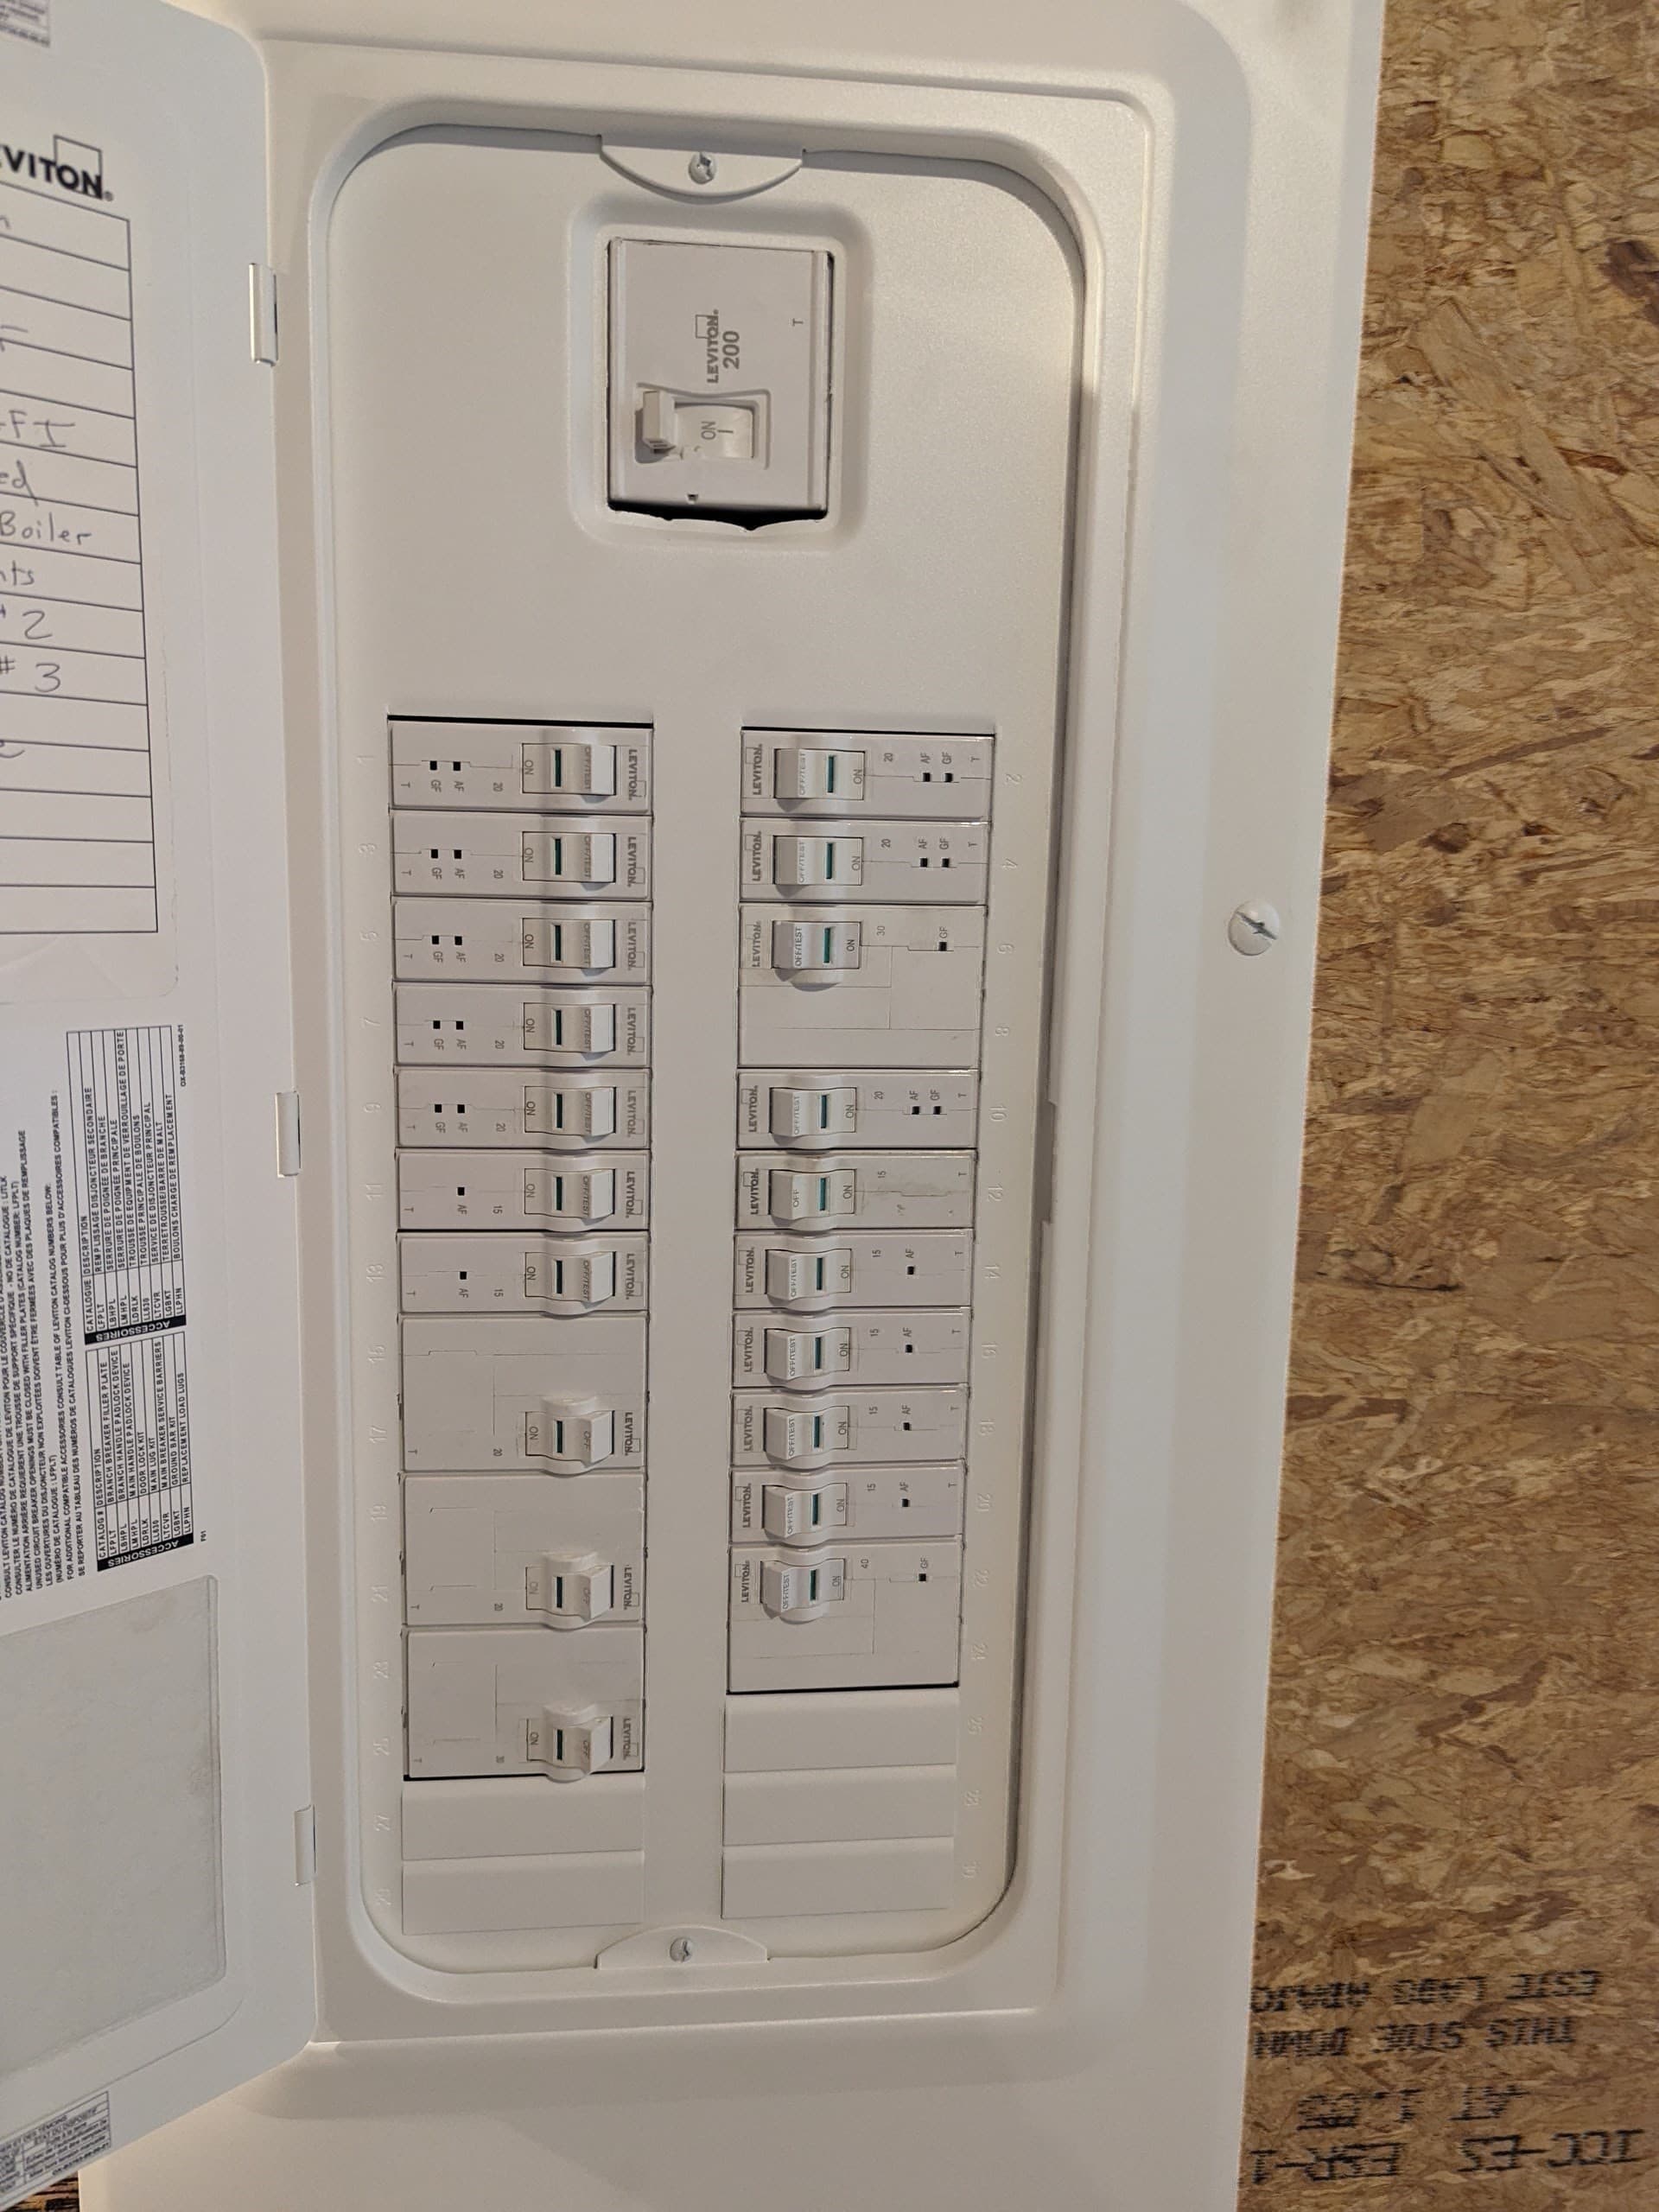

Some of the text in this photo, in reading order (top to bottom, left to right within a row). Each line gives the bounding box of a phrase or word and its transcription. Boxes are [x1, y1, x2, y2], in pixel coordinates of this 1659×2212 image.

[0, 144, 102, 200] VITON
[792, 318, 804, 327] T
[707, 312, 719, 384] LEVITON
[722, 330, 740, 370] 200
[701, 421, 716, 441] ON
[0, 510, 92, 546] Boiler
[22, 610, 54, 640] 2
[35, 662, 61, 693] 3
[884, 752, 893, 762] 20
[921, 752, 931, 764] AF
[942, 752, 952, 764] GF
[524, 760, 534, 775] ON
[629, 749, 639, 799] LEVITON
[753, 745, 762, 796] LEVITON
[854, 768, 863, 785] ON
[431, 780, 442, 792] GF
[454, 780, 464, 792] AF
[493, 782, 503, 792] 20
[881, 838, 891, 849] 20
[918, 838, 928, 849] AF
[939, 838, 950, 850] GF
[524, 848, 534, 863] ON
[627, 836, 637, 887] LEVITON
[752, 832, 761, 882] LEVITON
[852, 855, 861, 871] ON
[493, 869, 503, 880] 20
[876, 925, 885, 936] 30
[939, 926, 948, 938] GF
[524, 933, 534, 950] ON
[628, 921, 637, 969] LEVITON
[752, 922, 760, 968] LEVITON
[847, 938, 855, 952] ON
[495, 953, 504, 963] 20
[525, 1018, 535, 1033] ON
[627, 1007, 636, 1055] LEVITON
[495, 1039, 504, 1049] 20
[119, 1065, 125, 1076] DE
[874, 1090, 884, 1100] 20
[120, 1079, 130, 1144] VERROUILLAGE
[526, 1101, 536, 1116] ON
[627, 1090, 636, 1137] LEVITON
[748, 1086, 758, 1133] LEVITON
[846, 1104, 855, 1119] ON
[496, 1122, 505, 1133] 20
[124, 1147, 130, 1158] DE
[86, 1089, 101, 1272] REMPLISSAGE DISJONCTEUR SECONDAIRE
[877, 1170, 887, 1179] 15
[124, 1162, 133, 1211] EQUIPMENT
[525, 1183, 535, 1198] ON
[626, 1171, 635, 1217] LEVITON
[843, 1185, 852, 1199] ON
[493, 1205, 502, 1214] 15
[127, 1214, 134, 1224] DE
[81, 1217, 90, 1274] DESCRIPTION
[872, 1249, 881, 1258] 15
[527, 1266, 536, 1281] ON
[626, 1253, 635, 1299] LEVITON
[746, 1248, 754, 1294] LEVITON
[841, 1264, 849, 1279] ON
[493, 1288, 503, 1297] 15
[85, 1280, 93, 1331] CATALOGUE
[97, 1321, 169, 1341] ACCESSOIRES
[869, 1327, 879, 1337] 15
[54, 1334, 60, 1344] OF
[744, 1327, 753, 1373] LEVITON
[840, 1342, 849, 1357] ON
[868, 1405, 878, 1415] 15
[530, 1426, 538, 1440] ON
[744, 1407, 753, 1452] LEVITON
[838, 1421, 847, 1435] ON
[867, 1483, 875, 1492] 15
[742, 1484, 751, 1528] LEVITON
[836, 1497, 845, 1512] ON
[109, 1541, 178, 1567] ACCESSORIES
[861, 1558, 869, 1569] 40
[832, 1575, 841, 1587] ON
[530, 1732, 539, 1745] ON
[1506, 1968, 1603, 2000] ESTE
[1485, 2016, 1576, 2048] THIS
[1457, 2128, 1644, 2174] ICC-ES
